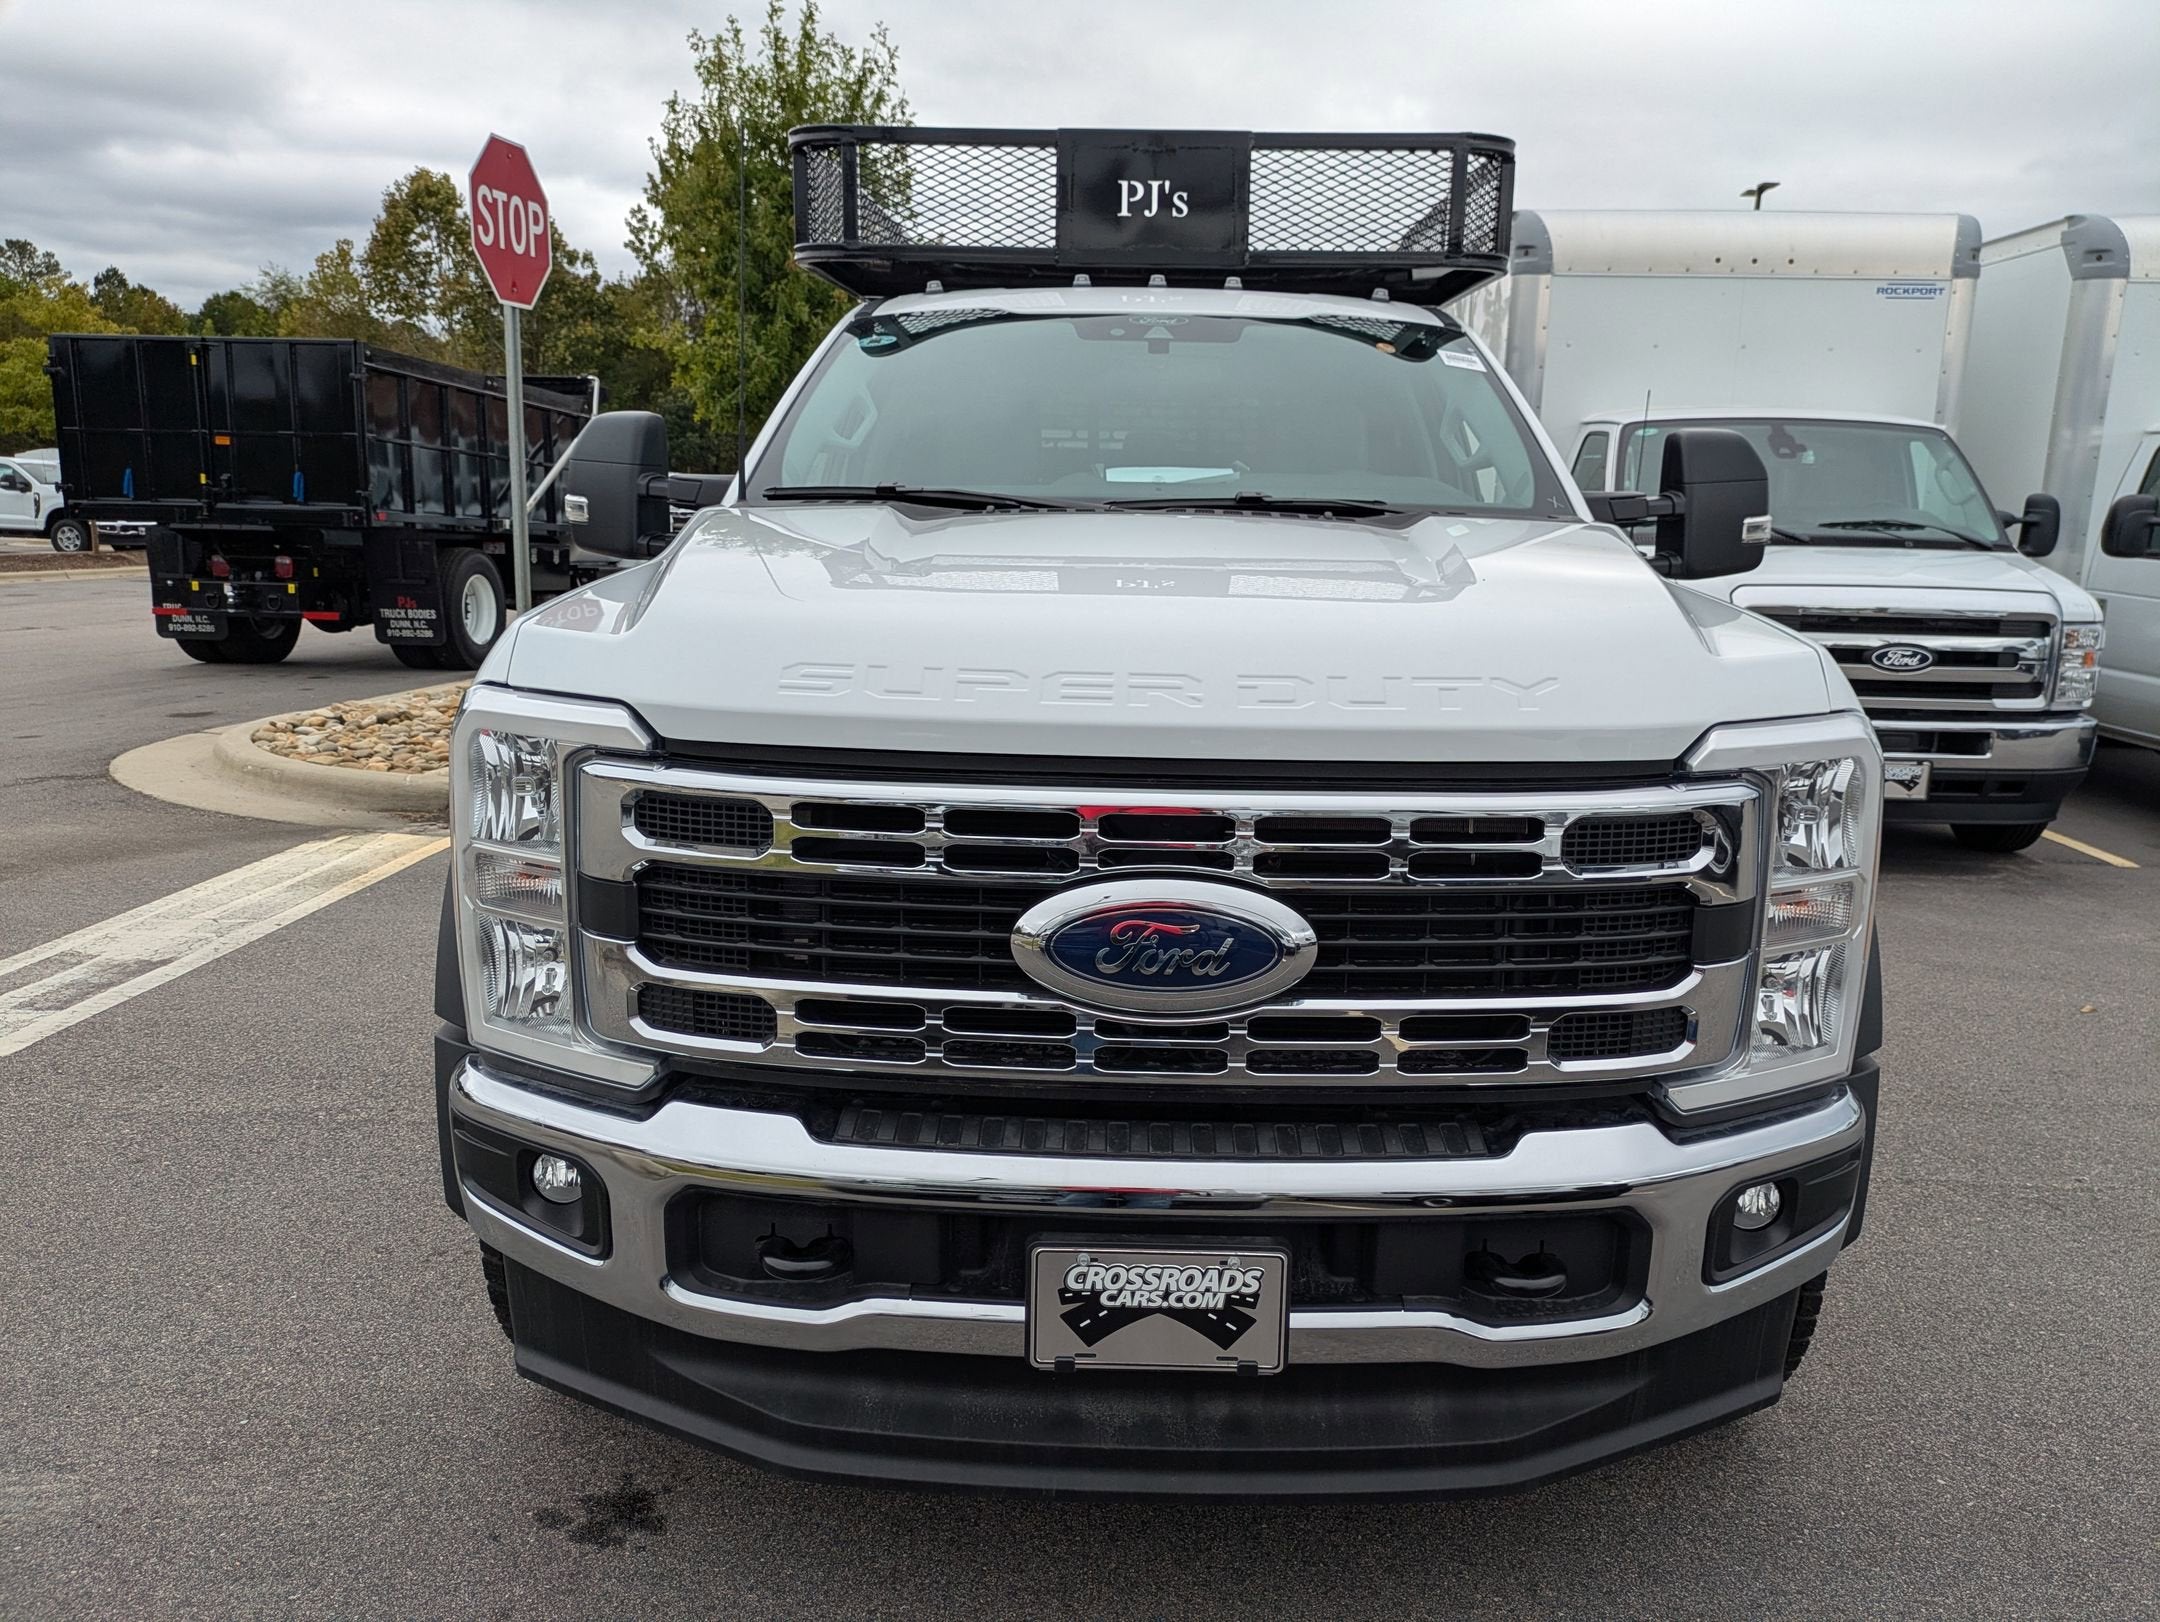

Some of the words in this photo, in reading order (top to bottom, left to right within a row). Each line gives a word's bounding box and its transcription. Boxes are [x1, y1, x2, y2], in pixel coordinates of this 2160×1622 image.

[1117, 180, 1189, 217] PJ's
[477, 184, 545, 258] STOP
[1876, 287, 1945, 296] ROCKPORT
[379, 608, 407, 618] TRUCK
[407, 609, 437, 619] BODIES
[1883, 650, 1922, 666] Ford
[778, 662, 1204, 708] SUPER
[1236, 674, 1561, 711] DUTY
[1095, 920, 1235, 977] Ford
[1065, 1263, 1264, 1295] CROSSROADS
[1099, 1289, 1227, 1310] CARS.COM
